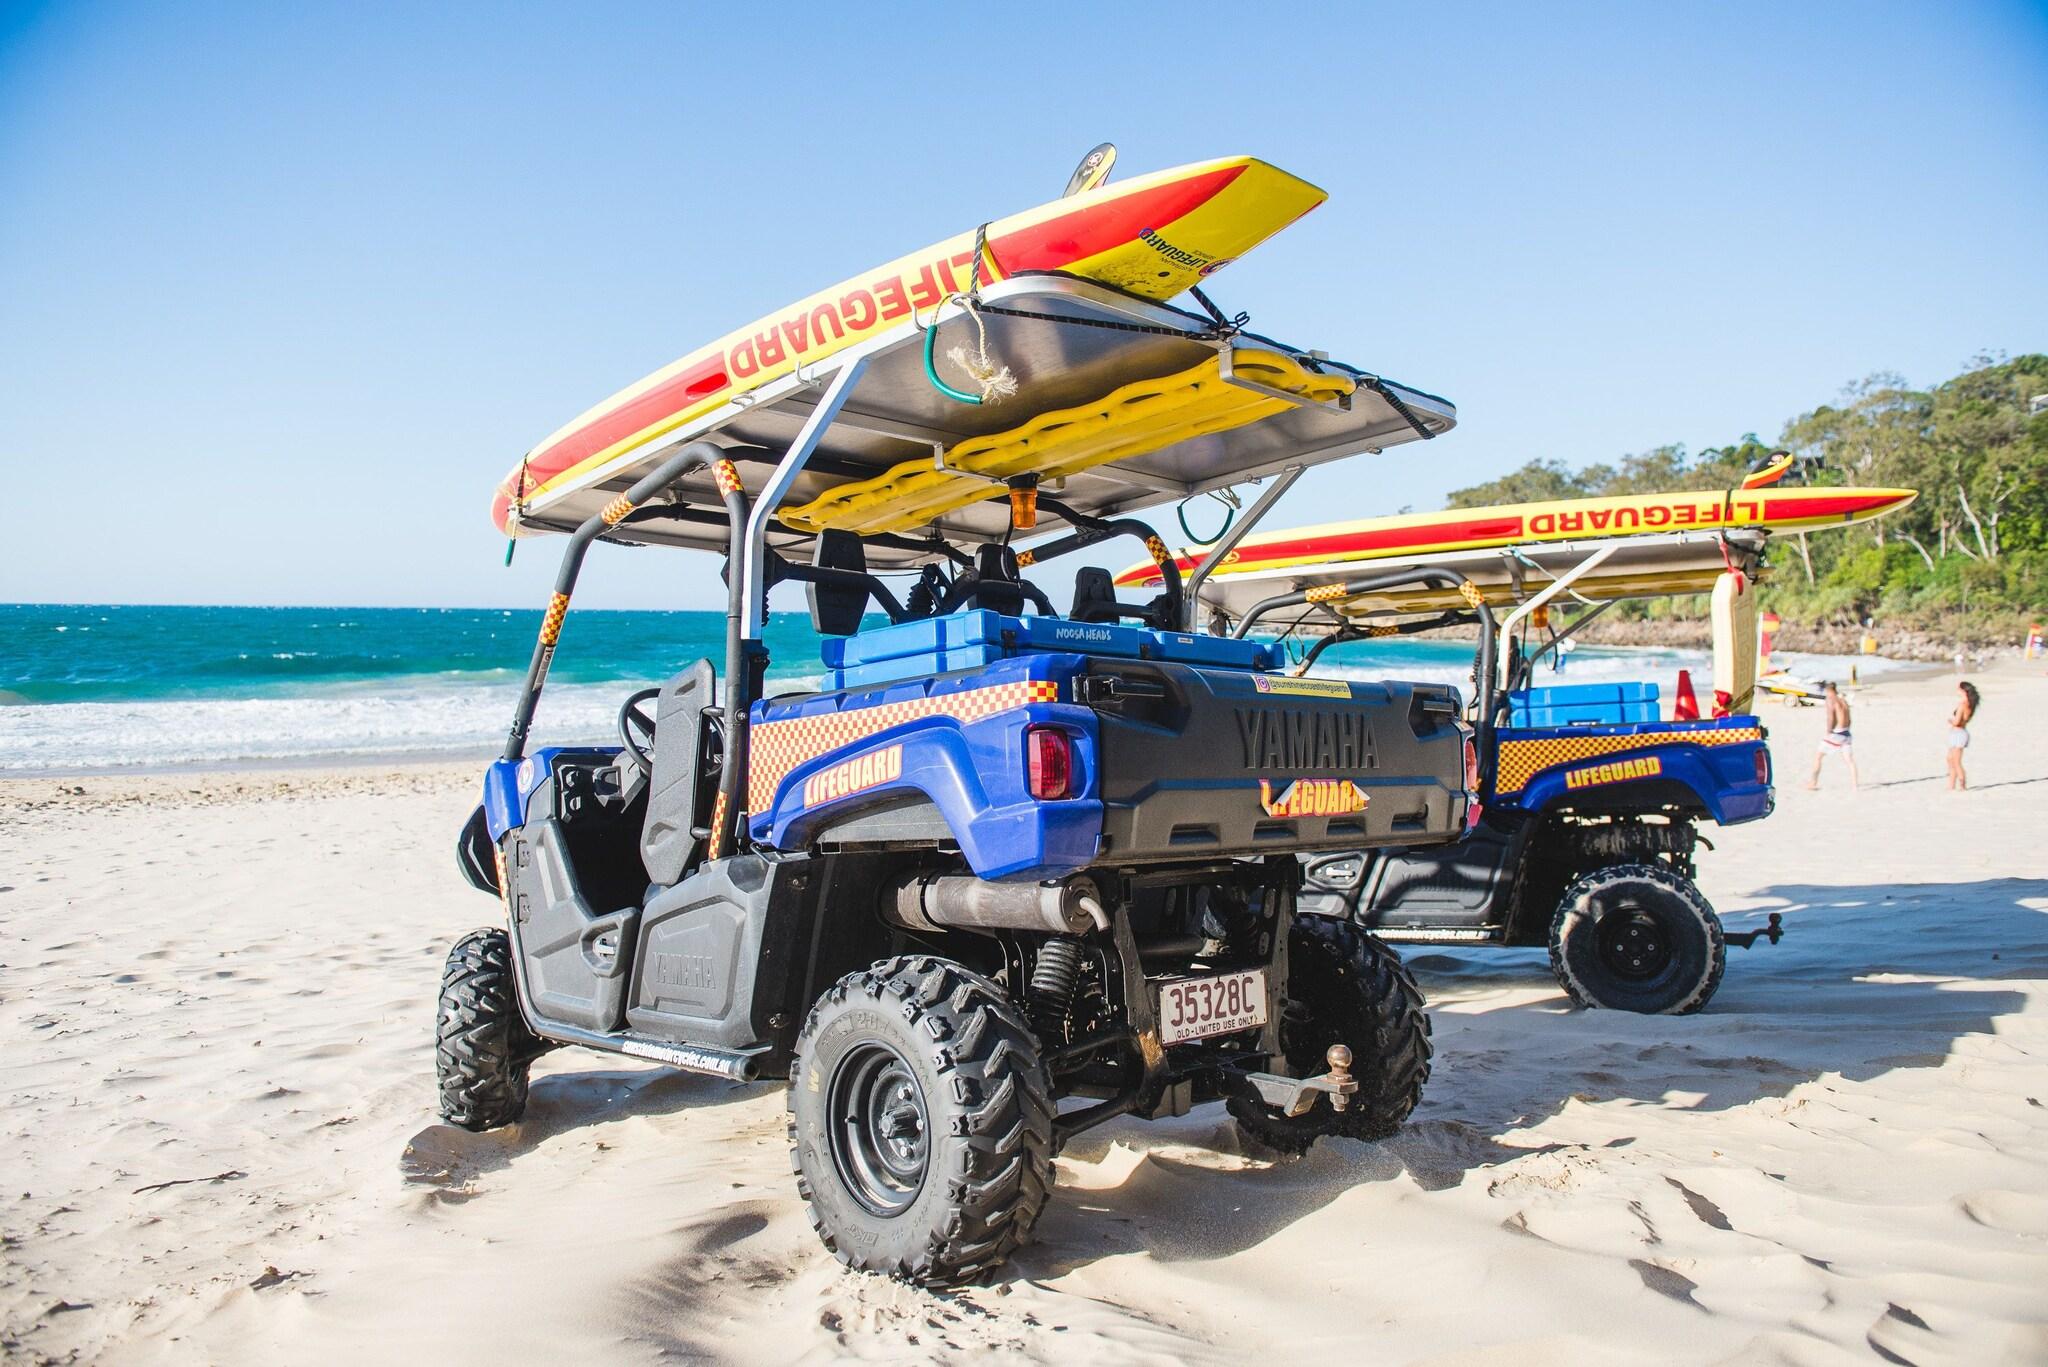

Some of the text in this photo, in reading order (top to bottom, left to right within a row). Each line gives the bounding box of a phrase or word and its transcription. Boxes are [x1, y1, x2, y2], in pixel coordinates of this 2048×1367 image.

[1139, 228, 1209, 268] LIFEGUARD
[729, 249, 997, 378] LIFEGUARD
[1529, 502, 1758, 534] LIFEGUARD
[1056, 628, 1112, 641] NOOSA HEADS
[1234, 708, 1380, 769] YAMAHA
[804, 744, 901, 809] LIFEGUARD
[1565, 756, 1661, 789] LIFEGUARD
[653, 952, 716, 989] YAMAHA
[1169, 976, 1256, 1027] 35328C
[1223, 1018, 1236, 1029] USE
